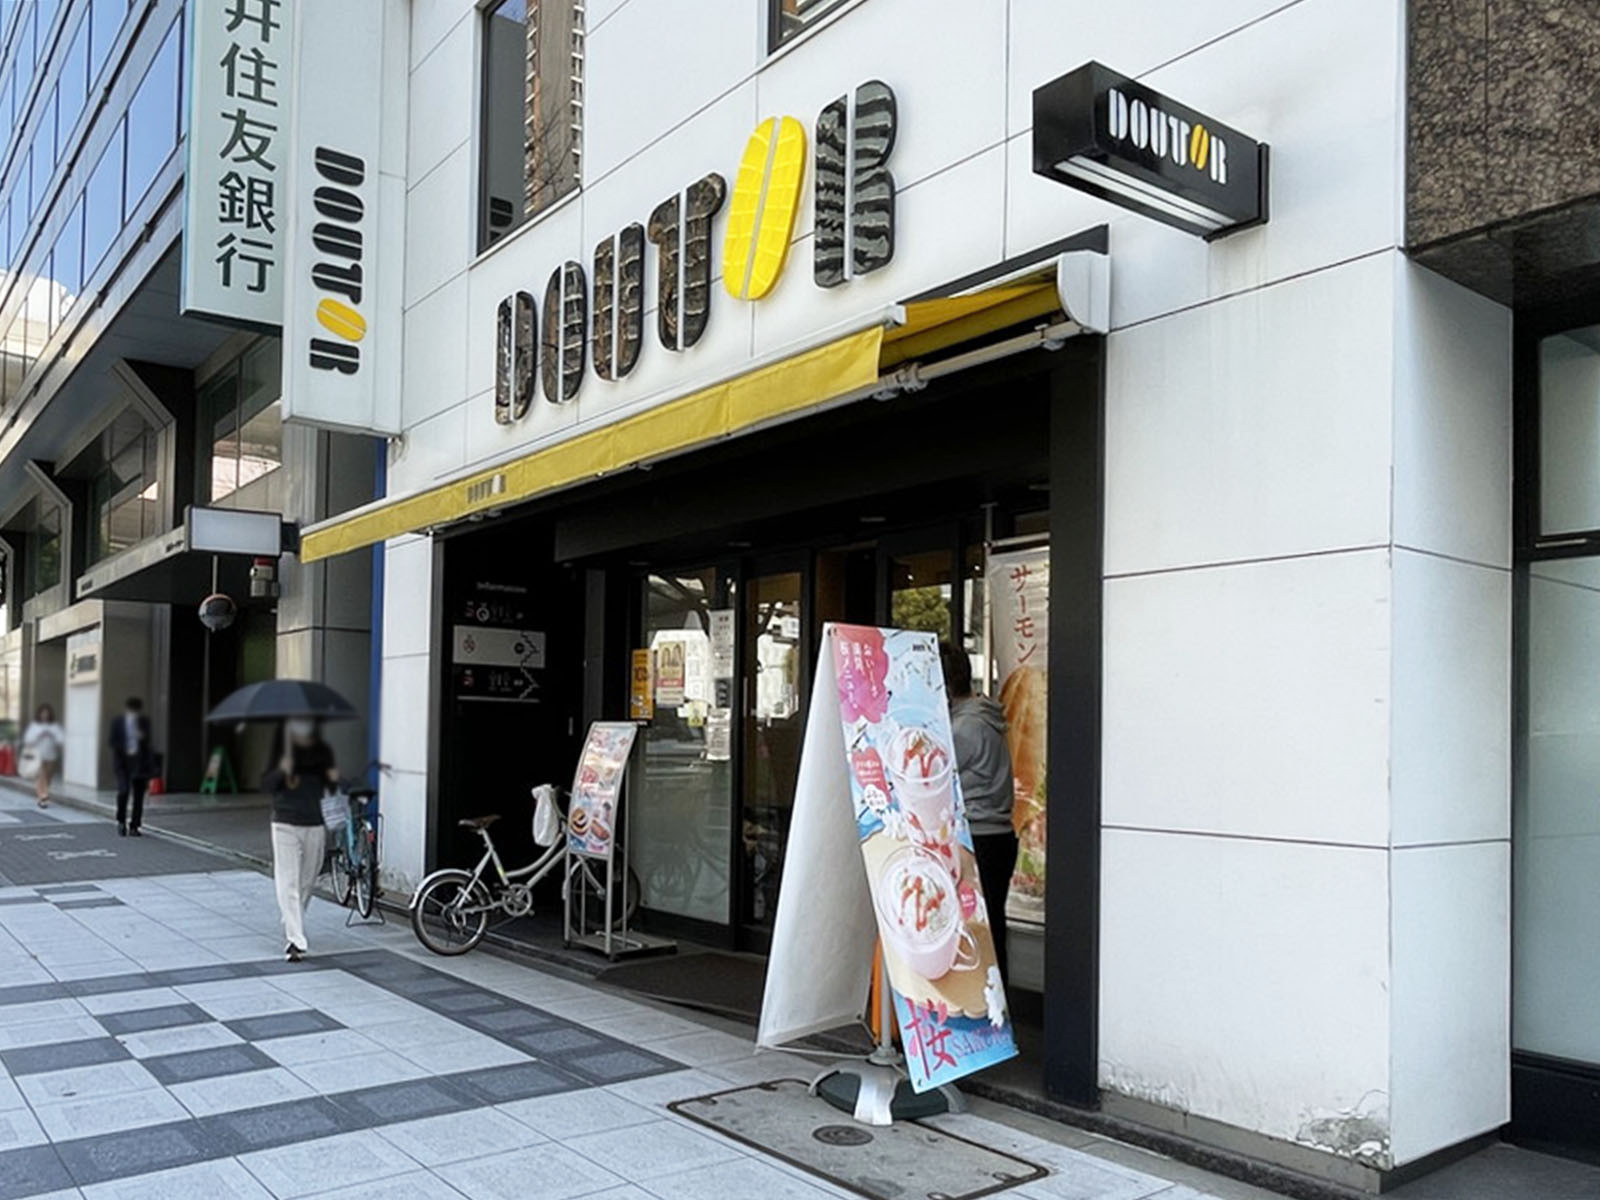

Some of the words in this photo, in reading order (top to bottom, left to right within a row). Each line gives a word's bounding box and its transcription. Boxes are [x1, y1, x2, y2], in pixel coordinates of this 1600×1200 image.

[216, 0, 281, 293] 井住友銀行
[1108, 88, 1227, 185] DOUTOR
[309, 146, 367, 376] DOUTOR
[495, 79, 898, 426] DOUTOR
[1010, 565, 1038, 664] サーモン
[904, 997, 958, 1081] 桜
